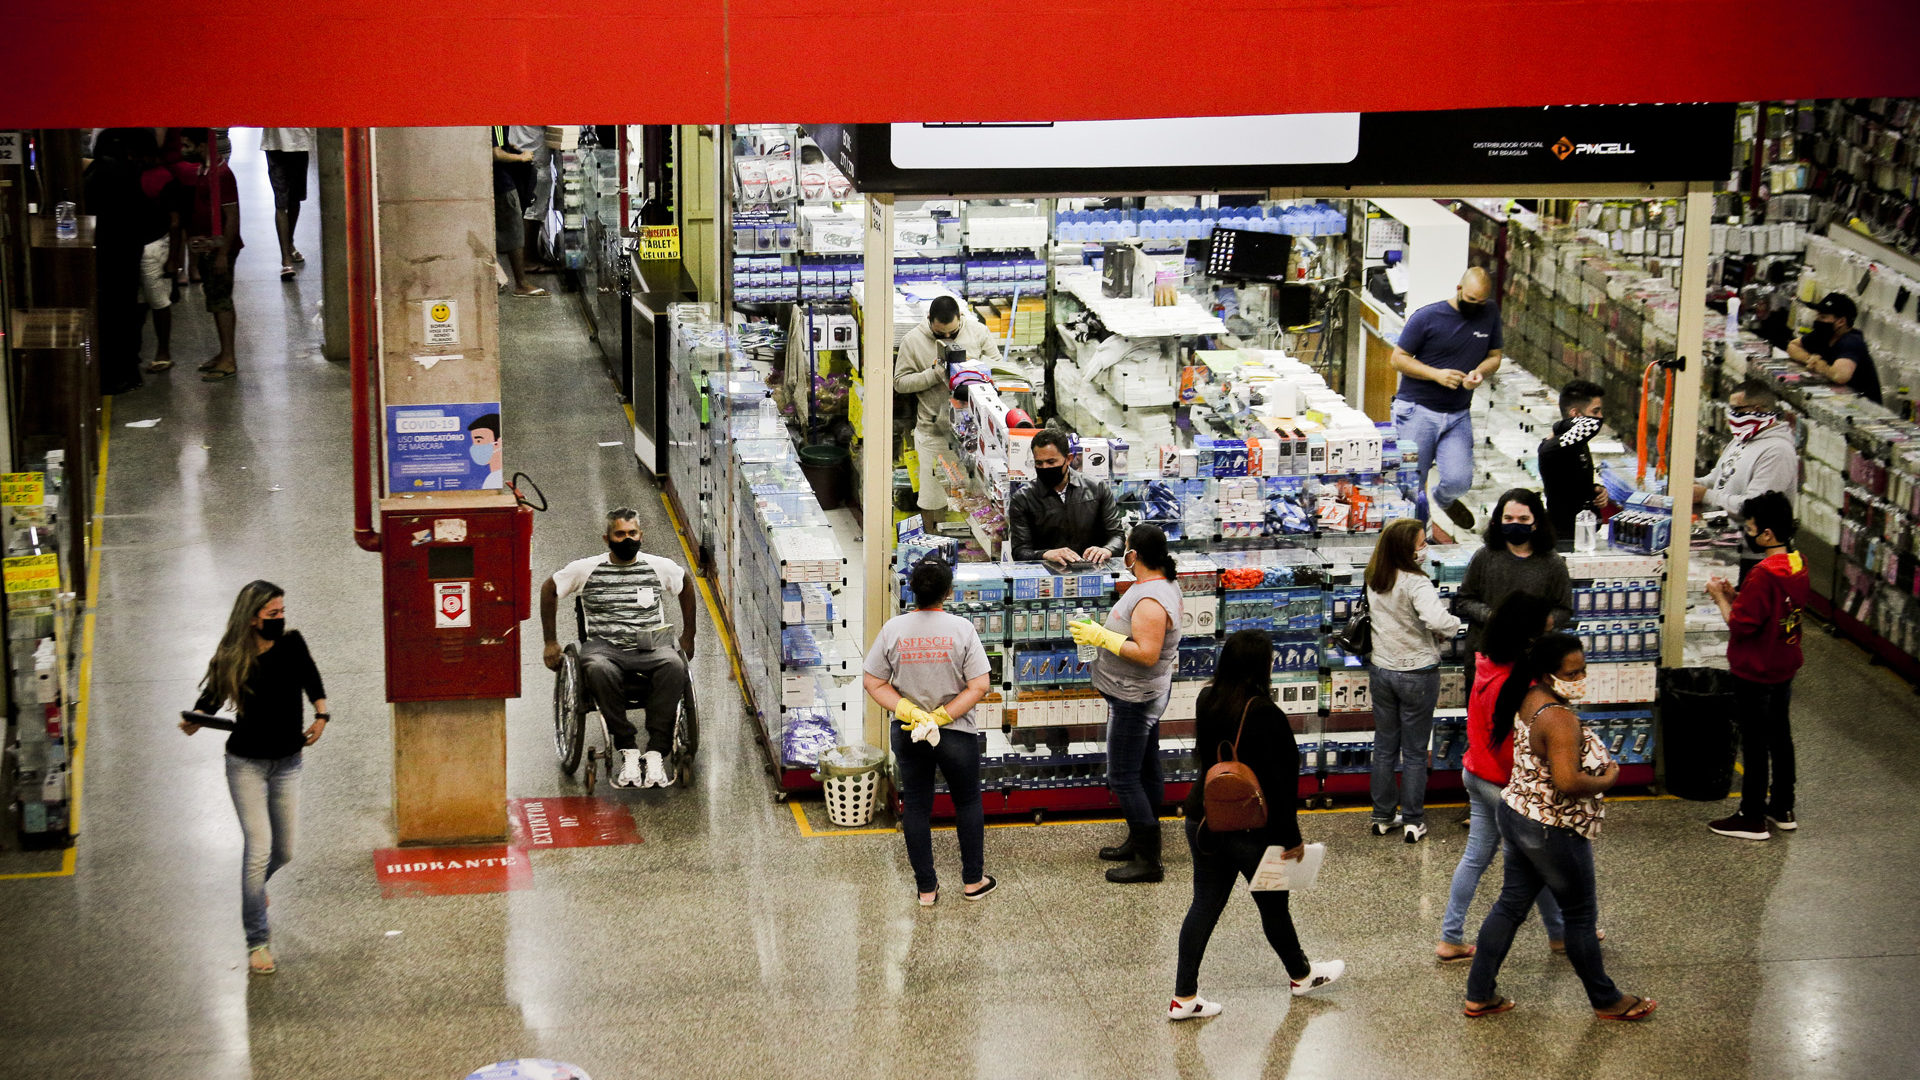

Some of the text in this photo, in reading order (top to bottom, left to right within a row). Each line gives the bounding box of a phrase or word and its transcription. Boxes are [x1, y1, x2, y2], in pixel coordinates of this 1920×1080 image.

[1575, 143, 1636, 155] PMCELL
[401, 419, 455, 430] COVID-19
[398, 433, 465, 443] USO OBRIGATÓRIO
[397, 443, 408, 451] DE
[524, 802, 553, 845] EXTINTOR
[558, 815, 580, 828] DE
[386, 856, 517, 874] HIDRANTE
